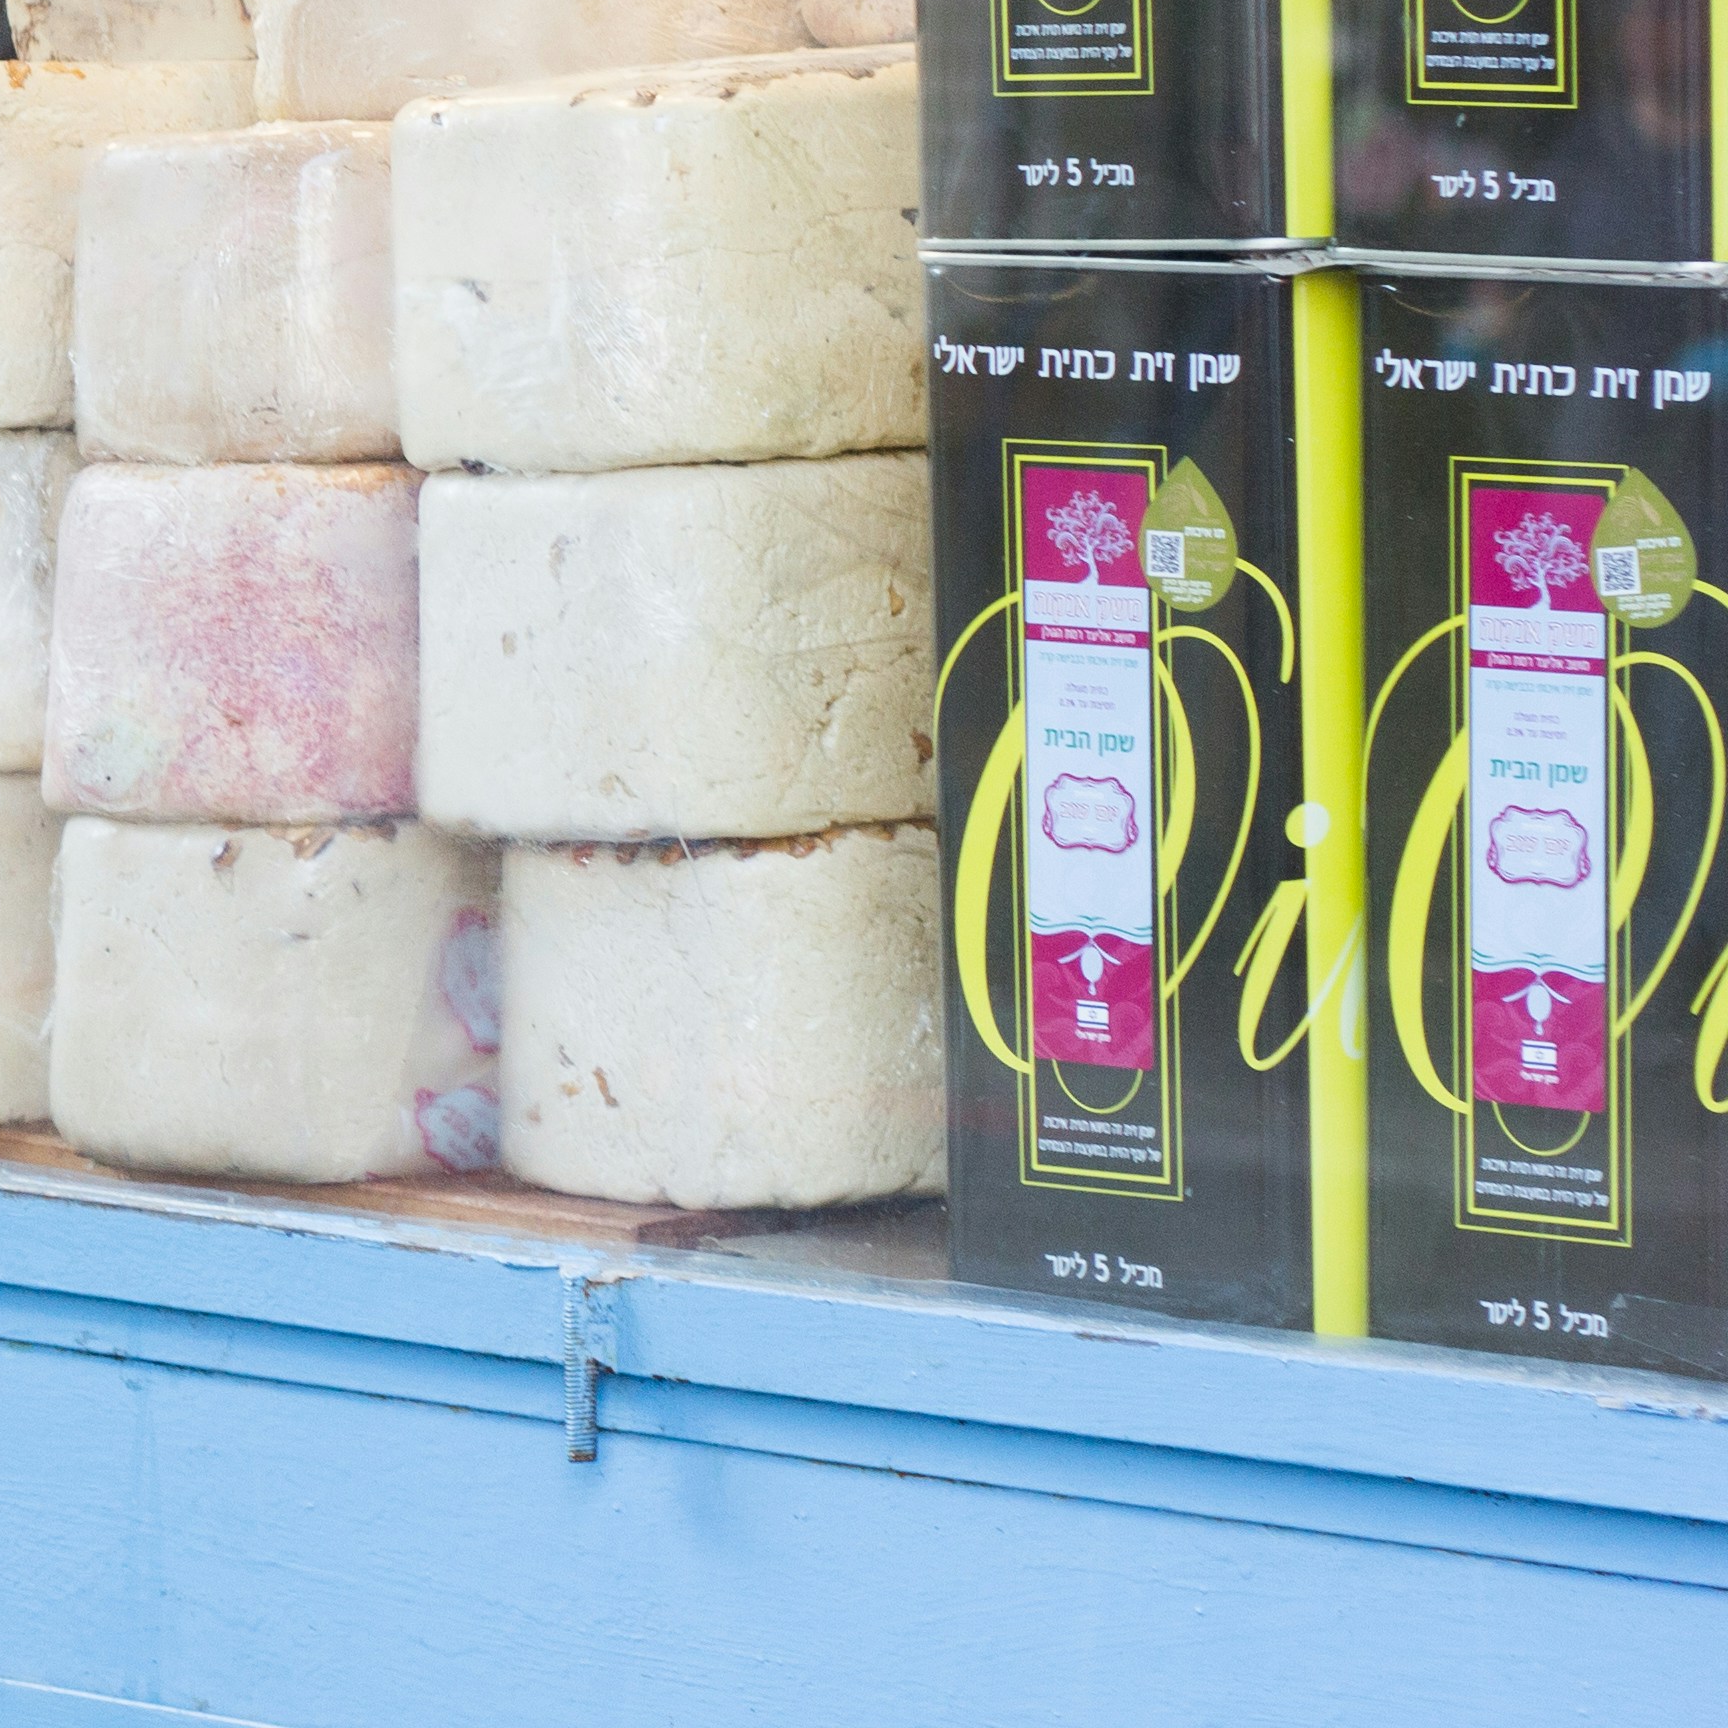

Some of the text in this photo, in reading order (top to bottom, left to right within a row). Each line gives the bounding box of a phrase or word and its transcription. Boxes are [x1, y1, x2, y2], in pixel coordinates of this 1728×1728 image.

[1018, 157, 1135, 189] מכיל 5 ליטר
[1432, 172, 1556, 203] מכיל 5 ליטר
[934, 336, 1240, 390] שמן זית כתית ישראלי
[1376, 349, 1711, 409] שמן זית כתית ישראלי
[1044, 727, 1134, 758] שמן הבית
[1489, 756, 1588, 788] שמן הבית
[1046, 1252, 1162, 1289] מכיל 5 ליטר
[1481, 1299, 1608, 1339] מכיל 5 ליטר
